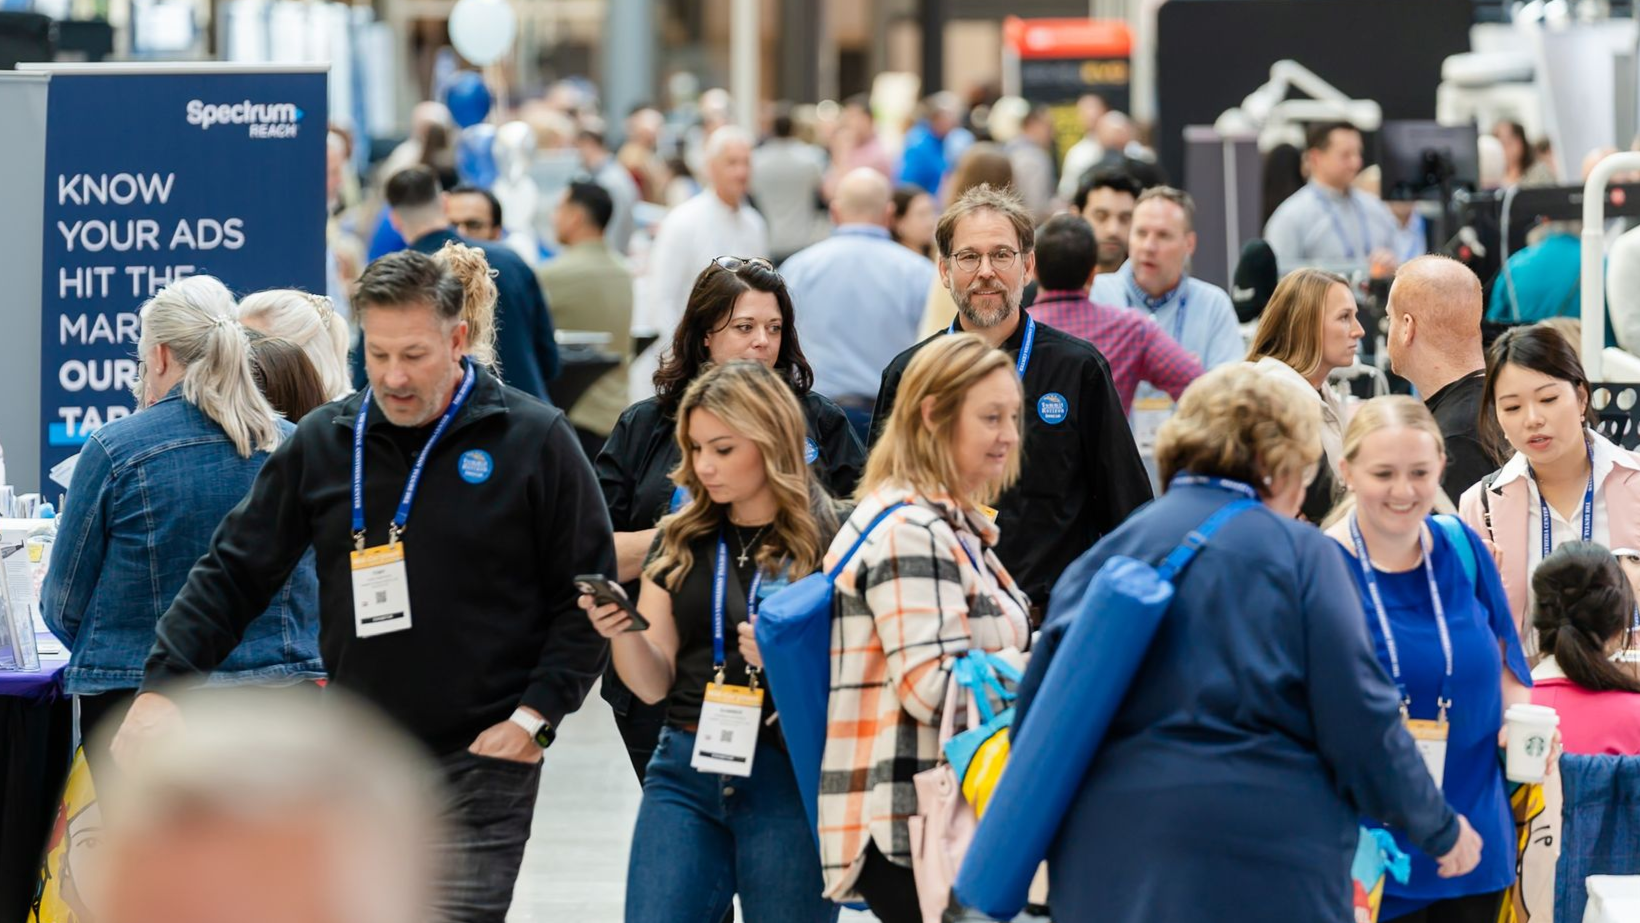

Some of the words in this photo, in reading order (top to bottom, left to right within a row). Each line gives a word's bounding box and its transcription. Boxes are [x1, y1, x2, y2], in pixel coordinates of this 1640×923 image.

[186, 99, 297, 130] Spectrum
[249, 123, 297, 138] REACH
[58, 172, 175, 206] KNOW
[57, 219, 161, 252] YOUR
[169, 217, 246, 251] ADS
[59, 266, 116, 299] HIT
[58, 359, 138, 392] OUR
